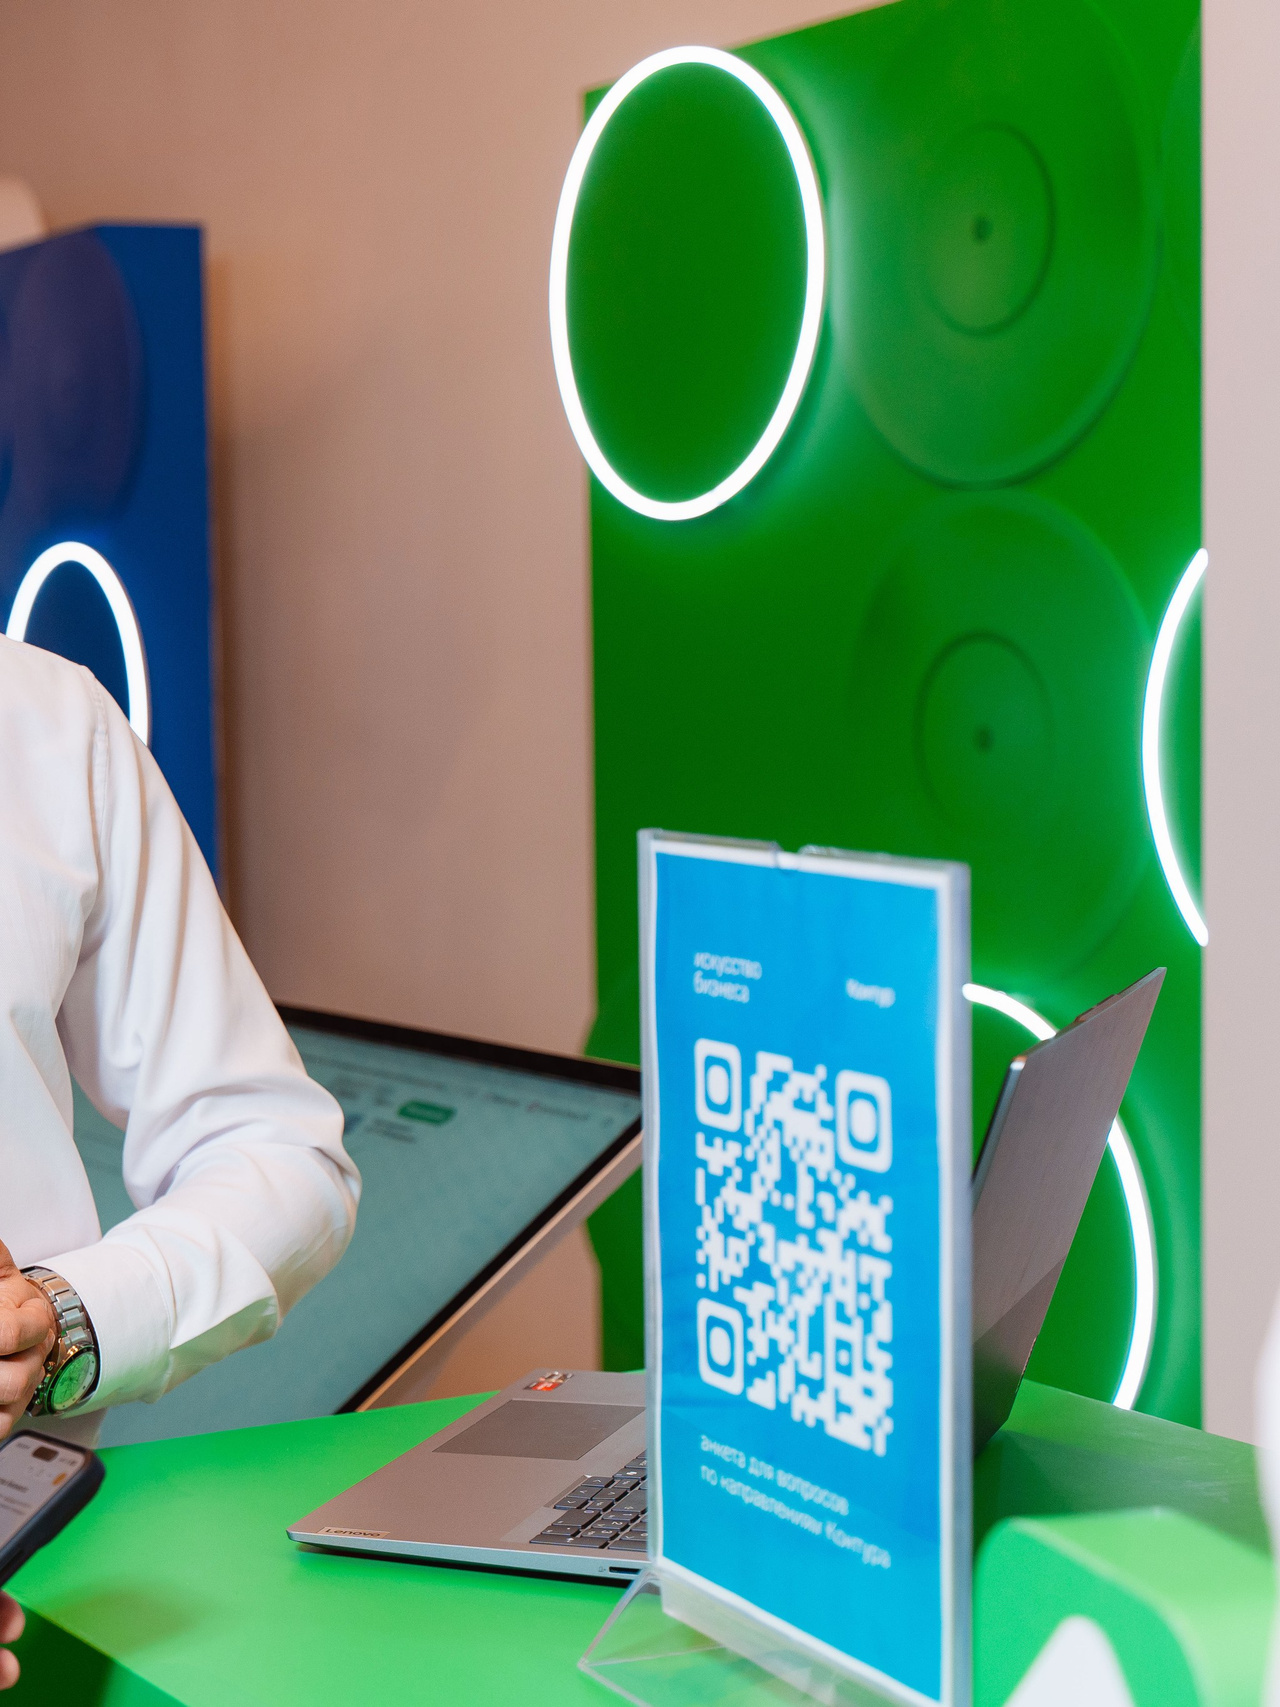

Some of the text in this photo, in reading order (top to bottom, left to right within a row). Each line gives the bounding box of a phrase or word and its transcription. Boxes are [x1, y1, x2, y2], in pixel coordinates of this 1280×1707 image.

[701, 1434, 746, 1469] анкета
[748, 1456, 775, 1480] для
[325, 1528, 381, 1537] Lenovo
[701, 1464, 718, 1486] по
[825, 1520, 891, 1569] Контура
